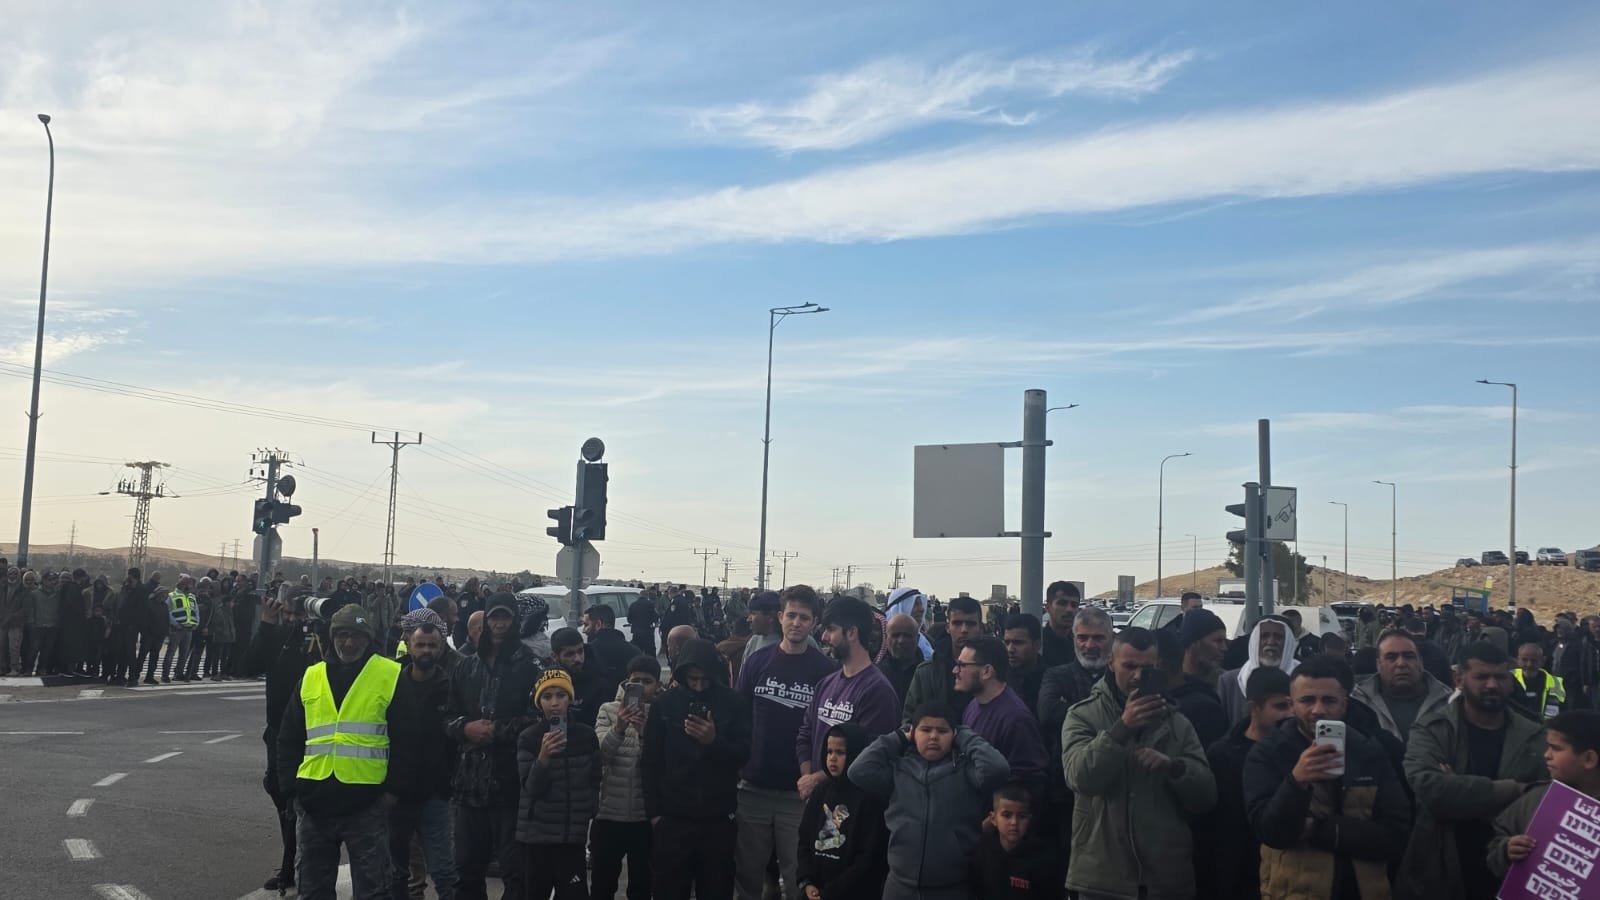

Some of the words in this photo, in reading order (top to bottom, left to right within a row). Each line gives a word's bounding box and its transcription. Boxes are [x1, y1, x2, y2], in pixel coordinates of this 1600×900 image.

[778, 689, 813, 702] עומדים
[1554, 832, 1600, 860] ليست
[1550, 848, 1588, 874] אינם
[1537, 860, 1581, 895] رخيصة
